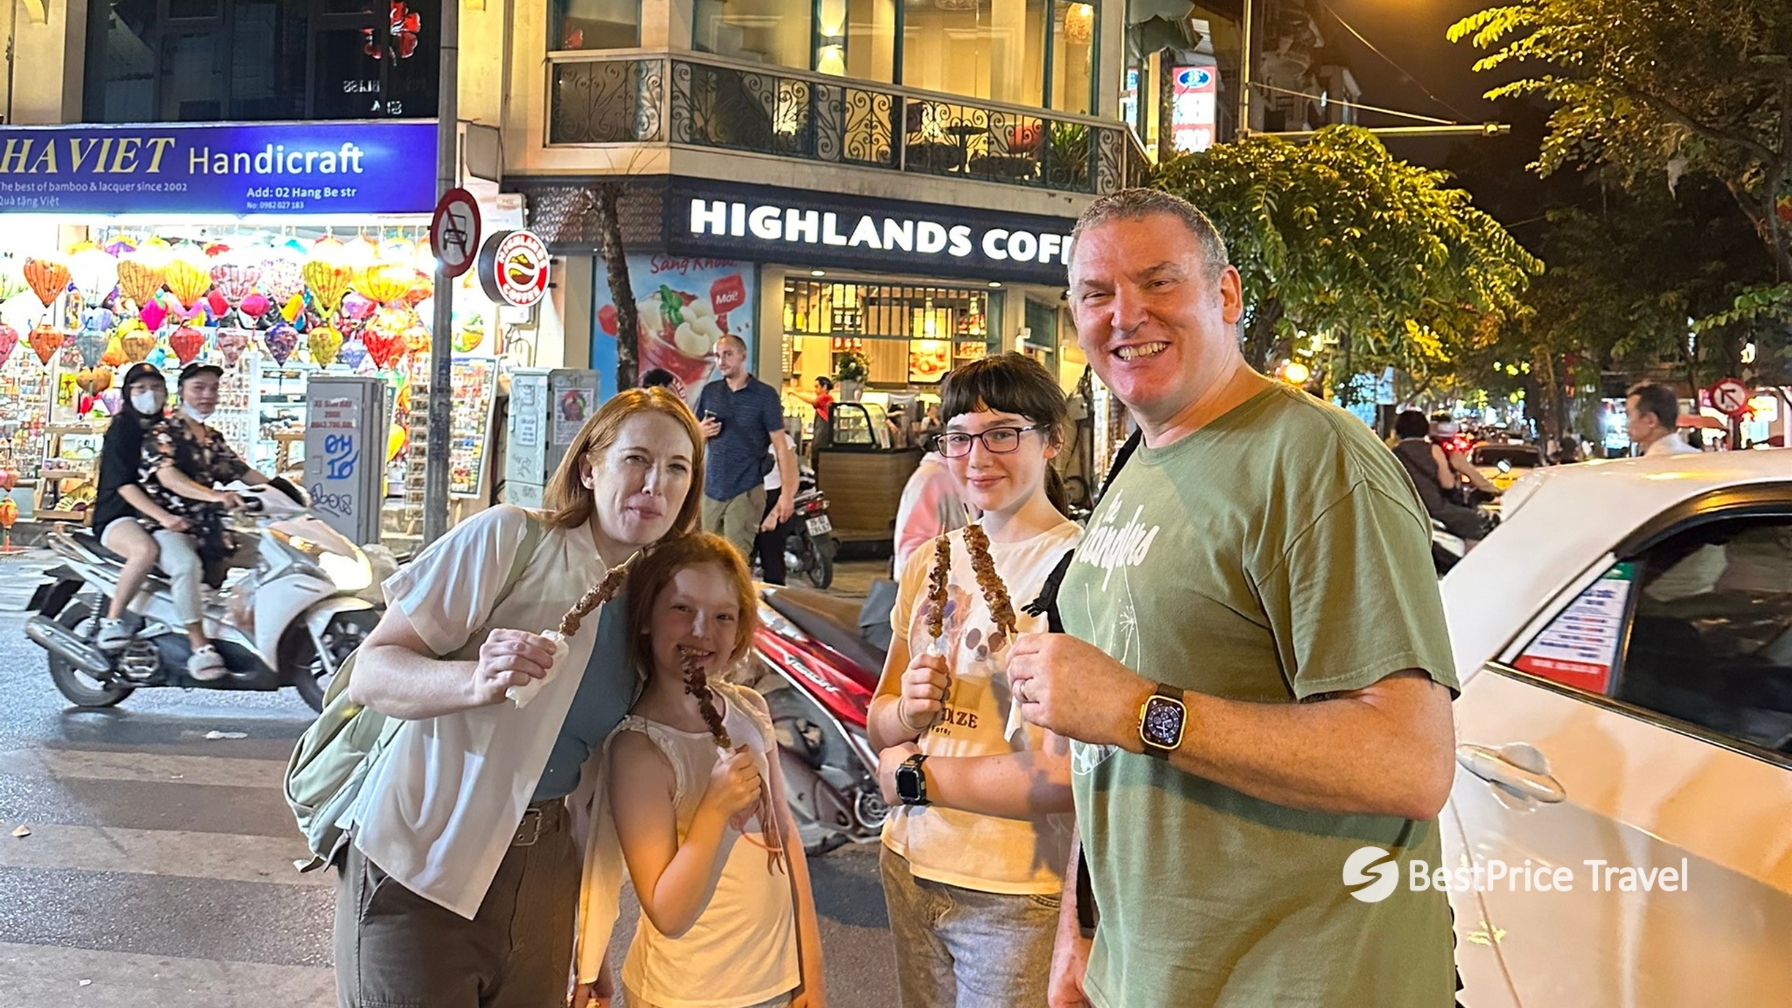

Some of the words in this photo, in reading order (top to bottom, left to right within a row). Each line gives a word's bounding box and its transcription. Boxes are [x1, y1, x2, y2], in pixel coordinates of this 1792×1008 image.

[188, 142, 364, 175] Handicraft
[15, 181, 35, 192] best
[37, 181, 48, 192] of
[49, 181, 89, 192] bamboo
[89, 182, 98, 192] &
[99, 181, 136, 194] lacquer
[137, 181, 163, 192] since
[164, 182, 188, 192] 2002
[246, 187, 274, 198] Add:
[275, 187, 290, 198] 02
[292, 187, 322, 200] Hang
[324, 186, 339, 198] Be
[341, 187, 357, 198] str
[690, 198, 973, 257] HIGHLANDS
[498, 233, 548, 270] HIGHLANDS
